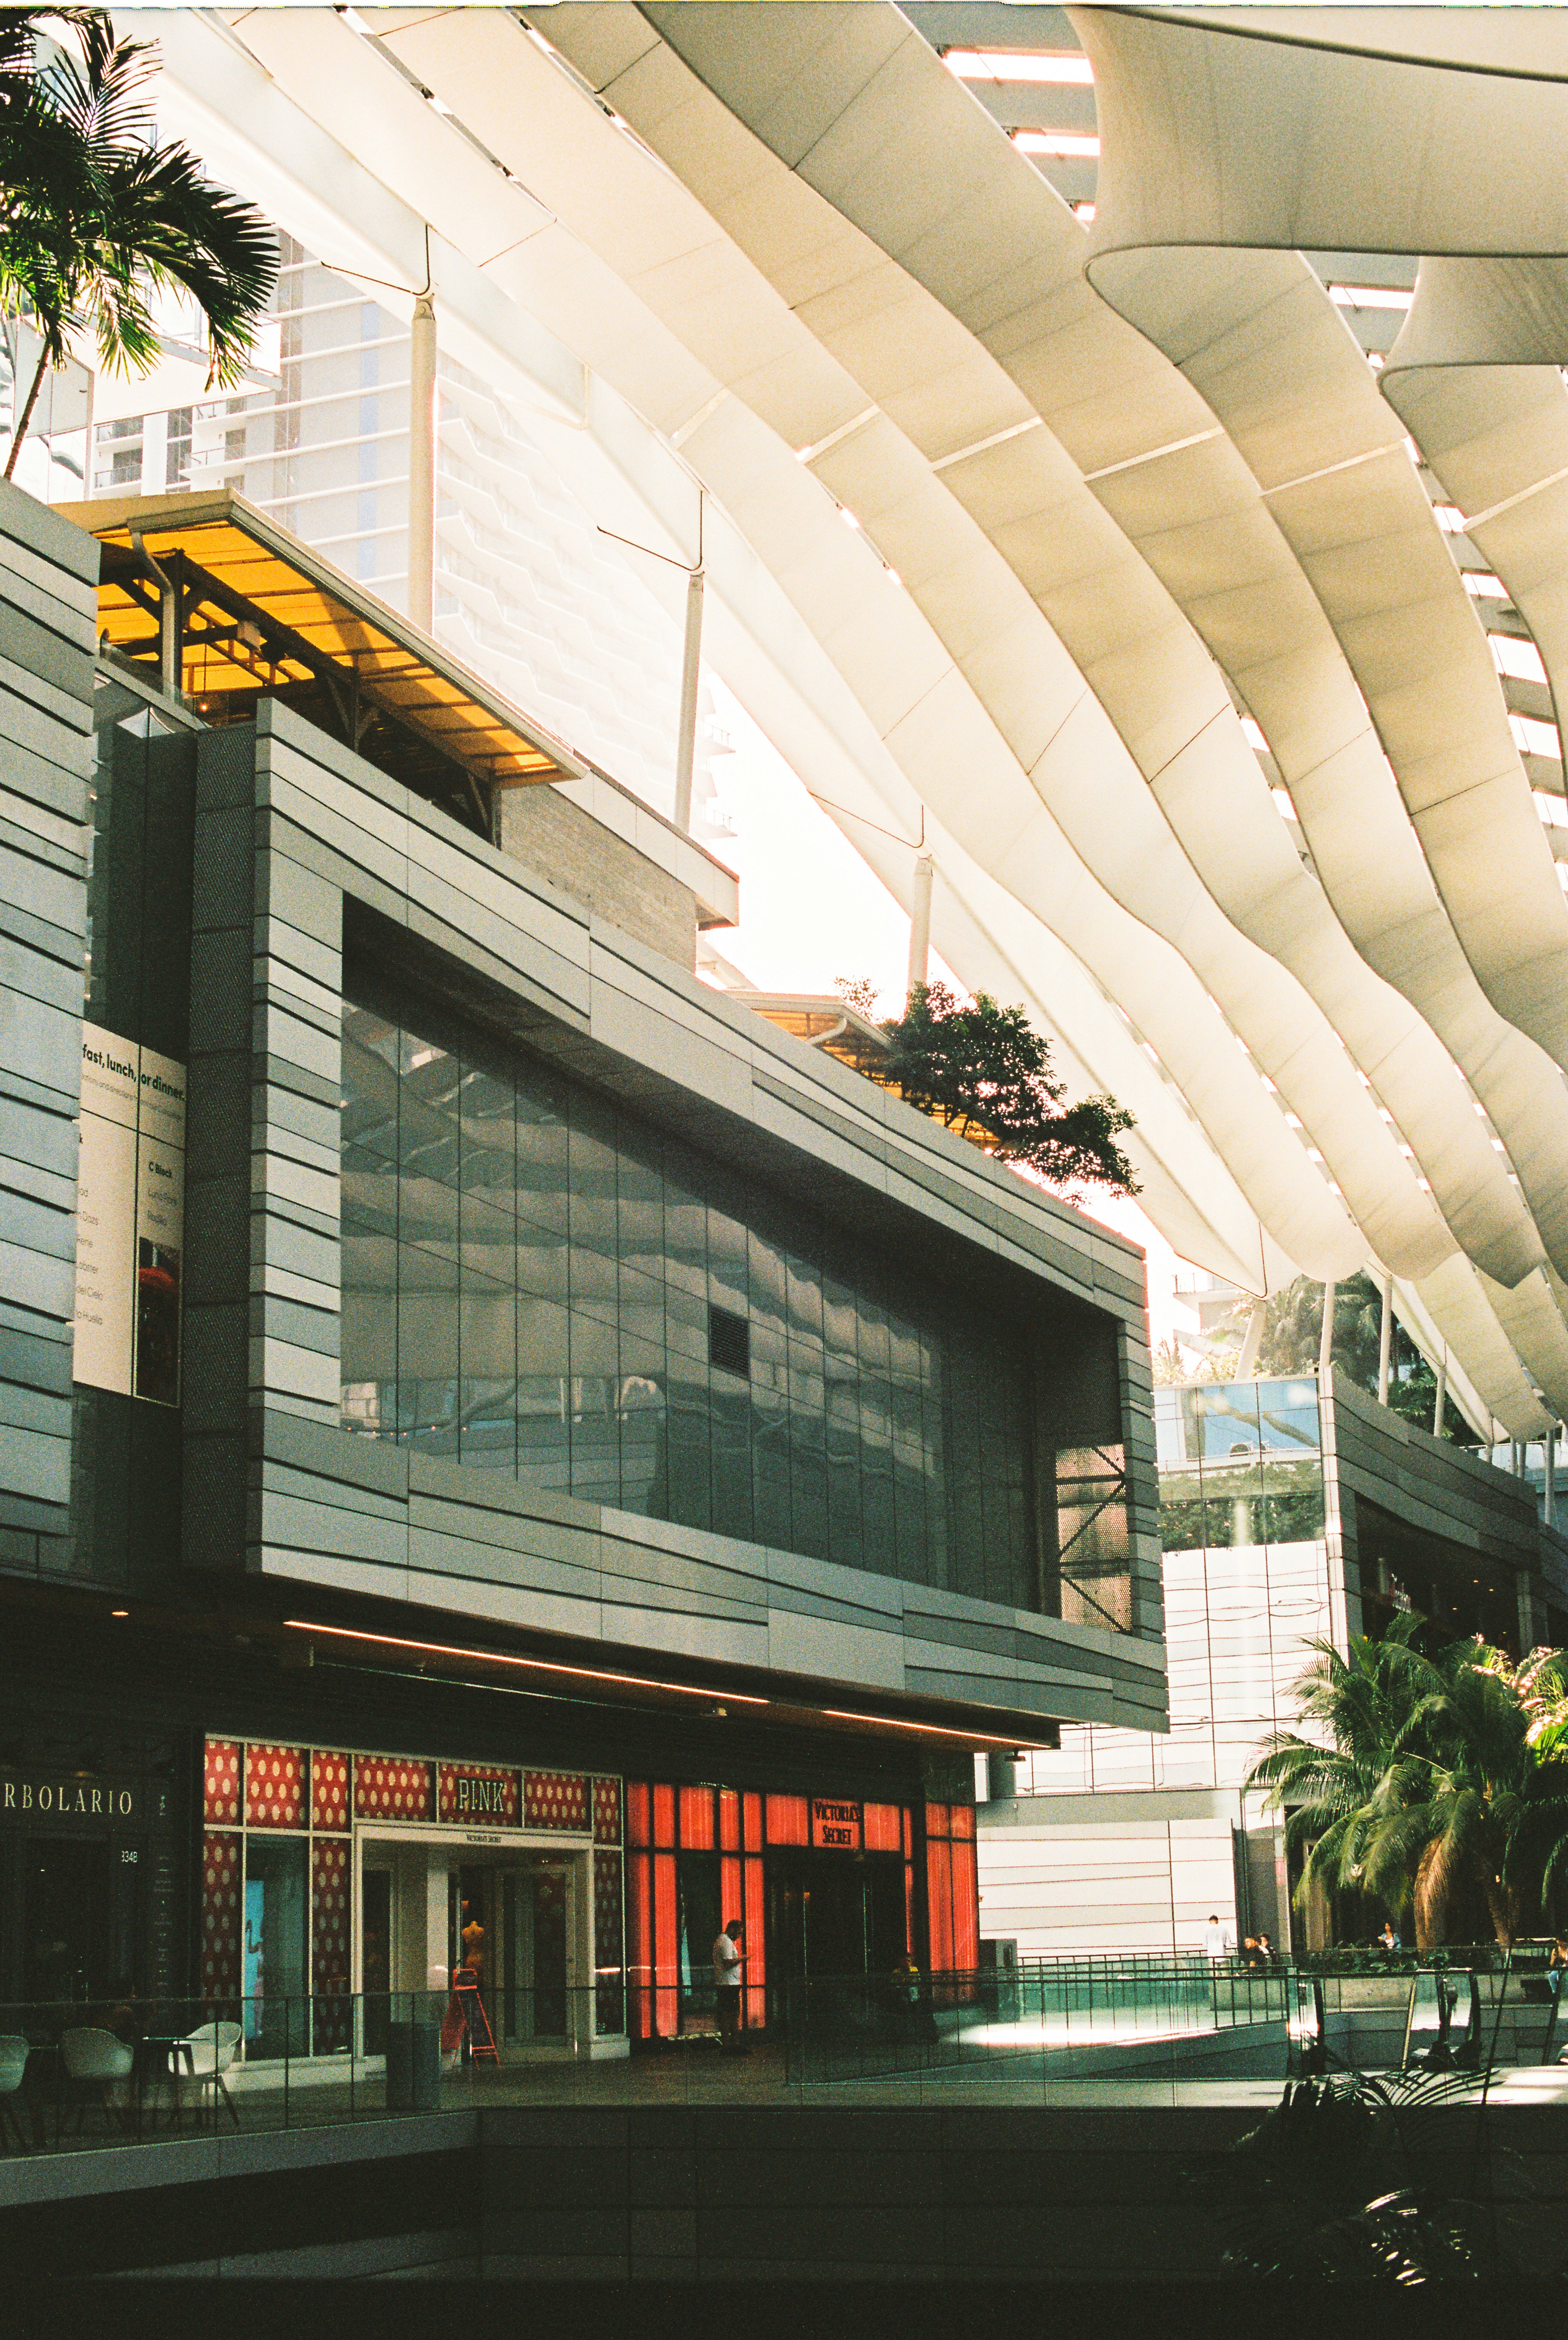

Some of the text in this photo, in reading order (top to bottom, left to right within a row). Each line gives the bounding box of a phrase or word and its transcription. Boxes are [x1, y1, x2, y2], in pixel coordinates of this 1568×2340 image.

[107, 1054, 136, 1082] lunch,
[141, 1074, 151, 1086] or
[149, 1162, 154, 1171] C
[4, 1783, 132, 1815] RBOLARIO
[459, 1779, 504, 1812] PINK
[823, 1825, 852, 1845] SECRET
